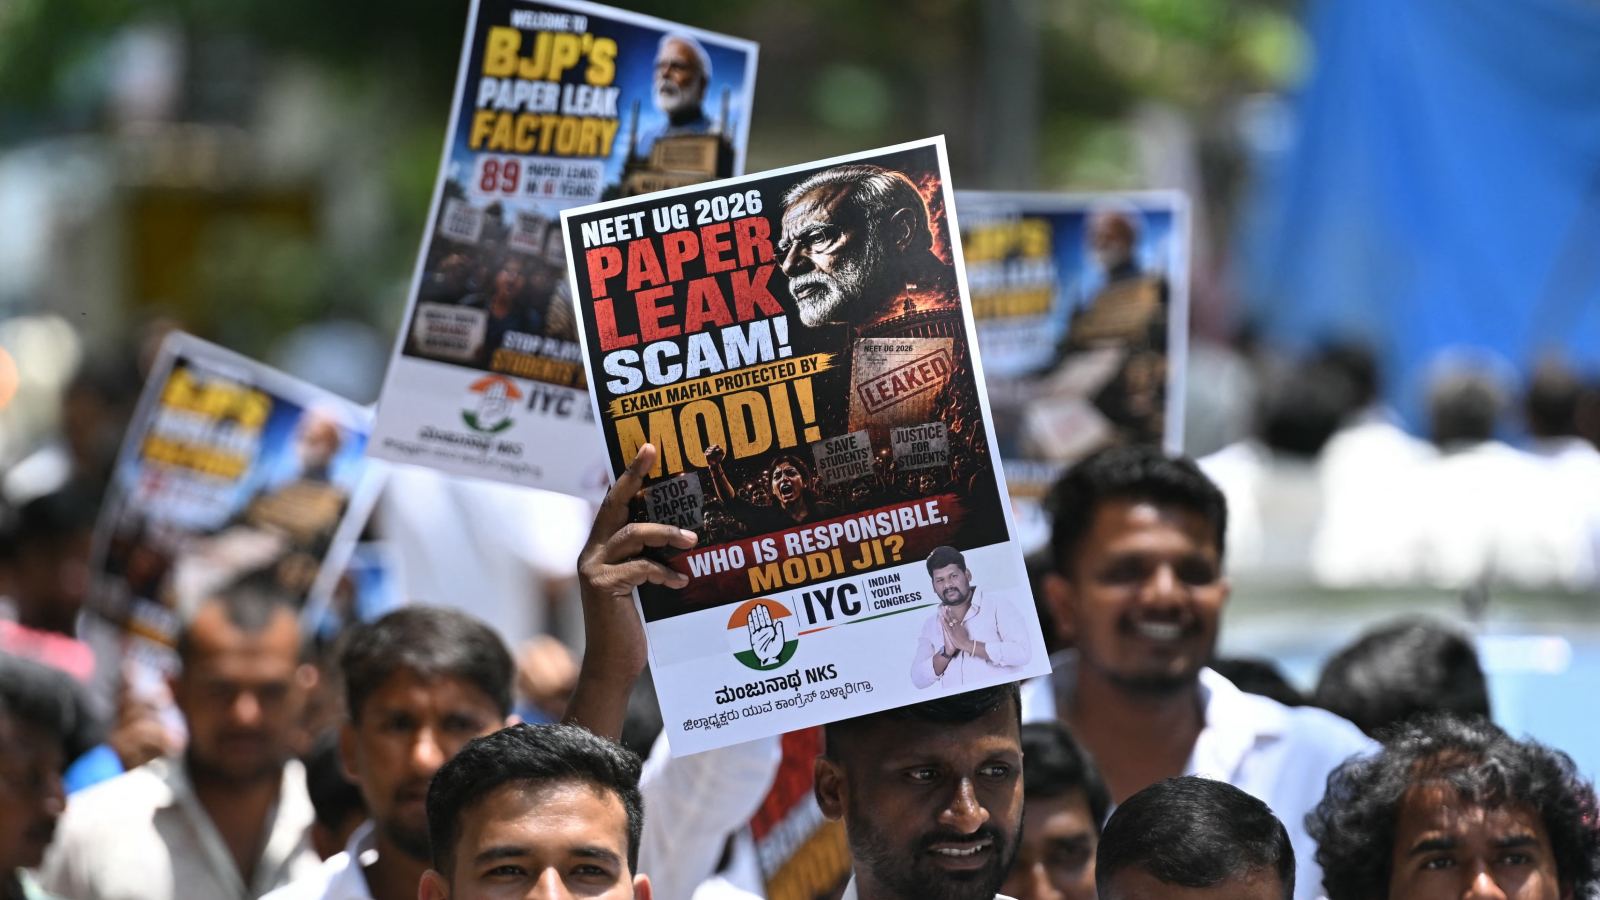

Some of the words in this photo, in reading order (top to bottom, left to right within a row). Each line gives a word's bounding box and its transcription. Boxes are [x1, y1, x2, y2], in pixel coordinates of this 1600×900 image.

[511, 10, 569, 30] WELCOME
[483, 26, 618, 87] BJP'S
[476, 78, 560, 113] PAPER
[561, 84, 620, 119] LEAK
[469, 110, 620, 157] FACTORY
[480, 158, 520, 193] 89
[581, 211, 645, 248] NEET
[652, 203, 689, 233] UG
[695, 189, 763, 225] 2026
[585, 216, 775, 299] PAPER
[594, 263, 786, 352] LEAK
[603, 315, 793, 395] SCAM!
[895, 344, 913, 352] 2026
[621, 392, 662, 414] EXAM
[666, 382, 712, 404] MAFIA
[715, 362, 797, 392] PROTECTED
[801, 357, 819, 373] BY
[864, 355, 947, 407] LEAKED
[526, 385, 576, 418] IYC
[615, 376, 822, 480] MODI!
[895, 425, 943, 444] JUSTICE
[819, 446, 870, 470] STUDENTS'
[825, 436, 857, 455] SAVE
[899, 450, 947, 468] STUDENTS
[911, 441, 930, 454] FOR
[825, 460, 870, 484] FUTURE
[652, 480, 689, 505] STOP
[654, 494, 698, 520] PAPER
[687, 545, 745, 578] WHO
[752, 538, 778, 564] IS
[784, 500, 949, 554] RESPONSIBLE,
[748, 548, 845, 593] MODI
[852, 535, 905, 571] JI?
[868, 572, 901, 588] INDIAN
[802, 583, 862, 625] IYC
[871, 584, 902, 600] YOUTH
[874, 591, 922, 610] CONGRESS
[715, 669, 801, 705] ಮಂಜುನಾಥ
[805, 663, 838, 684] NKS
[742, 701, 773, 718] ಯುವ
